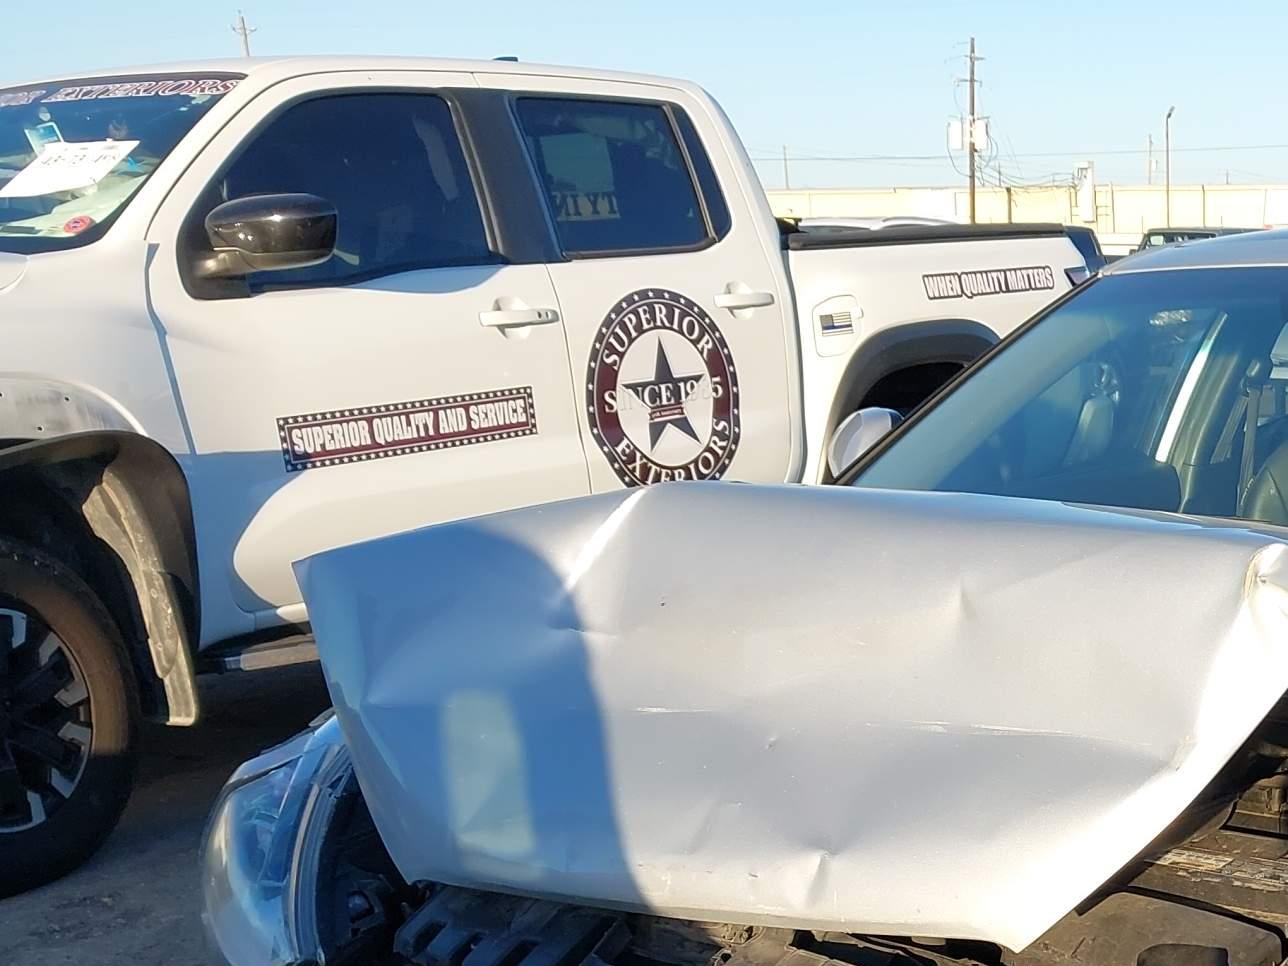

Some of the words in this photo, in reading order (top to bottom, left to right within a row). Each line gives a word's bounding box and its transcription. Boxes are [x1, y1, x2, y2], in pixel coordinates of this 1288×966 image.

[925, 274, 962, 299] WHEN
[961, 270, 1007, 298] QUALITY
[1006, 266, 1054, 293] MATTERS
[602, 303, 714, 371] SUPERIOR
[291, 421, 371, 455] SUPERIOR
[372, 411, 436, 445] QUALITY
[439, 407, 467, 435] AND
[469, 398, 527, 432] SERVICE
[614, 418, 729, 486] EXTERIORS
